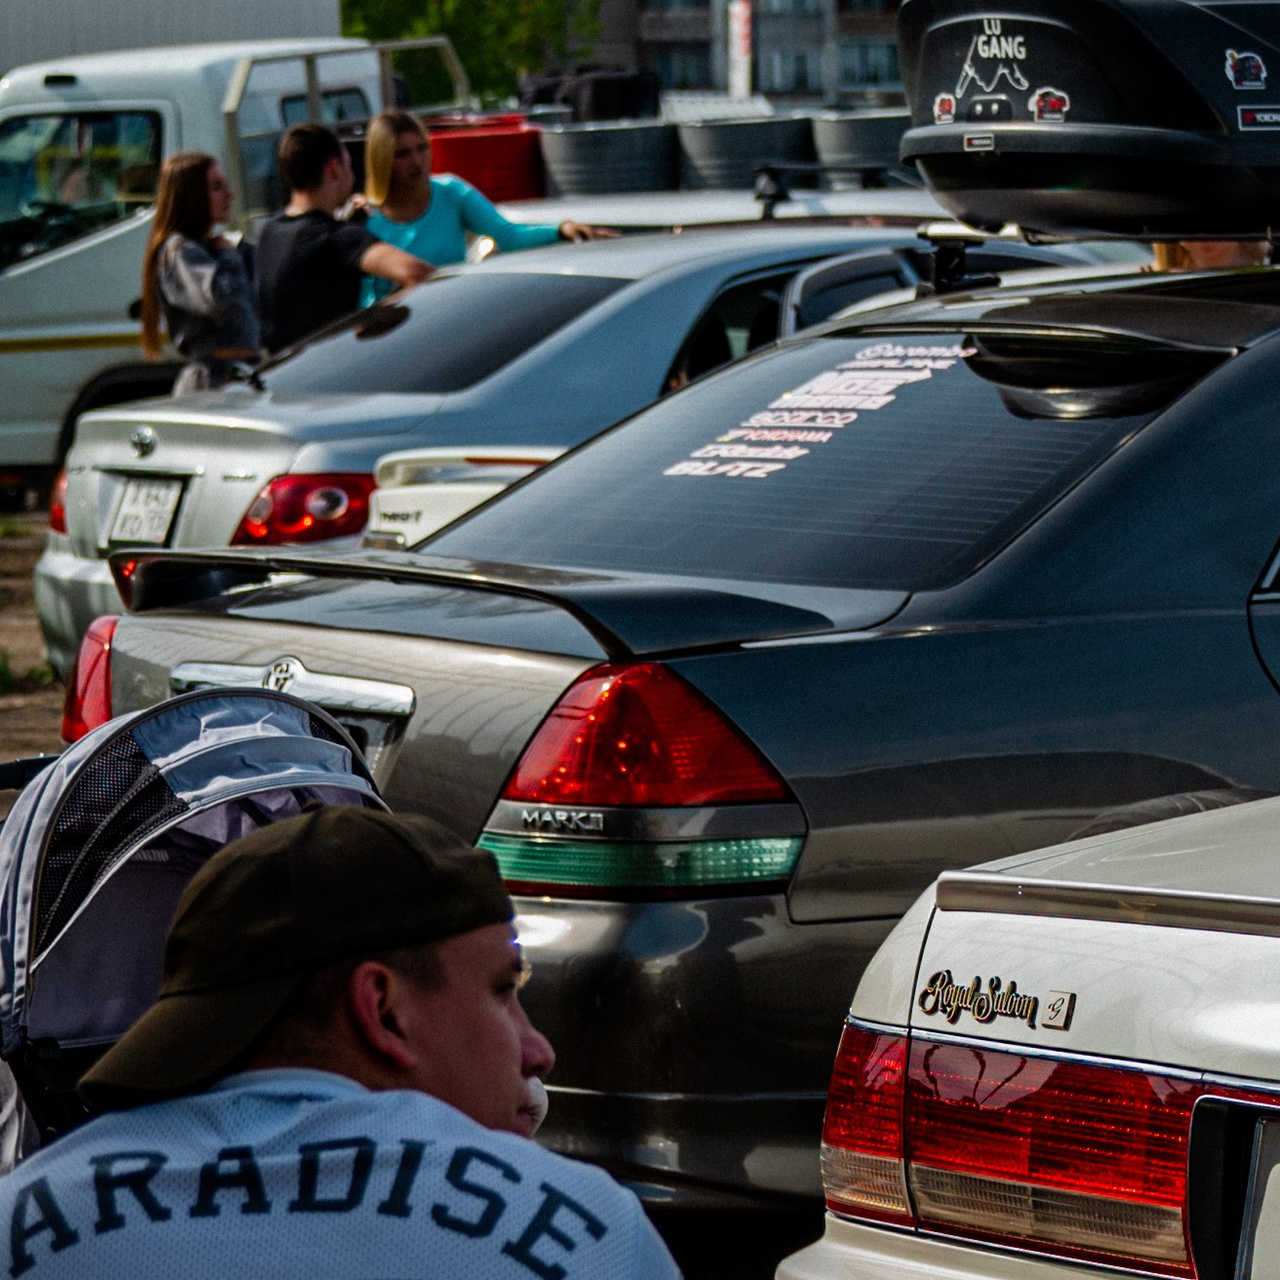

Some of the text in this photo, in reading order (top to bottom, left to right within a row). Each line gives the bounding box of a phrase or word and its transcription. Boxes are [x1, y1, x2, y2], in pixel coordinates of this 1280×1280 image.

[977, 35, 1027, 60] GANG
[919, 969, 982, 1025] Royal
[972, 976, 1039, 1030] Saloon
